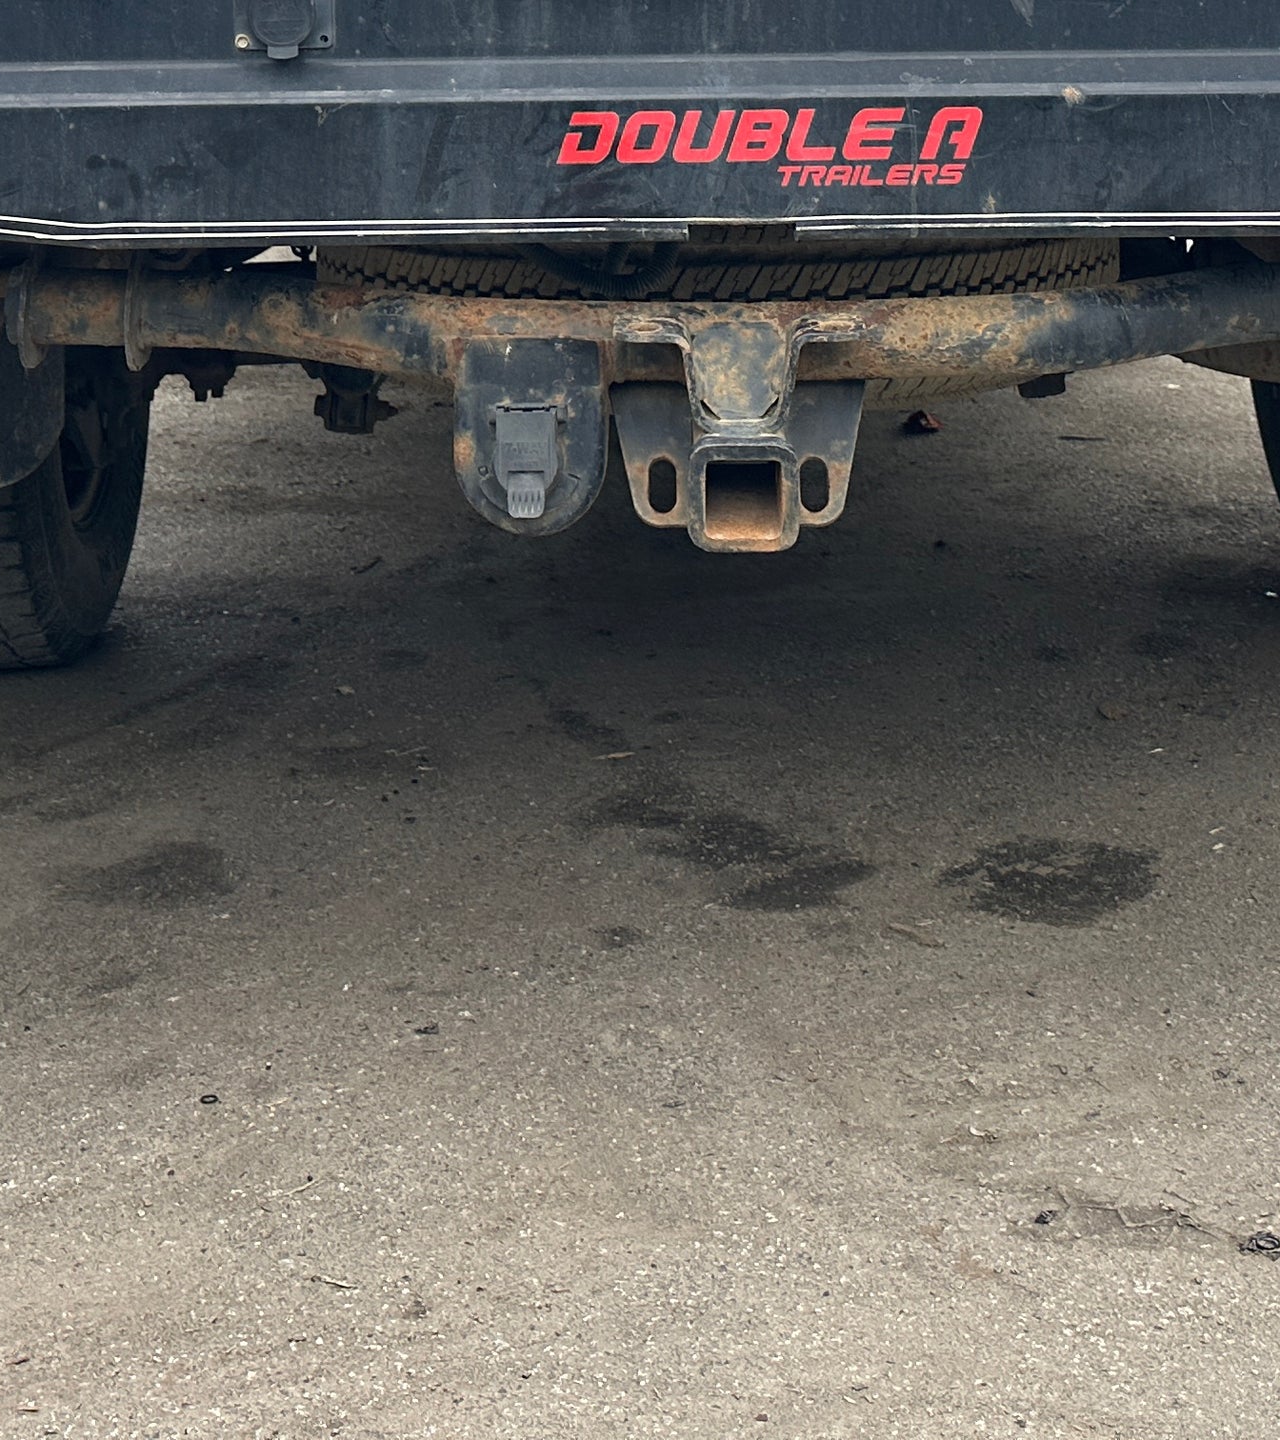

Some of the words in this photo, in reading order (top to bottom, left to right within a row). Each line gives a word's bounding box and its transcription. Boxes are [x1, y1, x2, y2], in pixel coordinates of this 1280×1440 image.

[556, 107, 906, 165] DOUBLE
[920, 106, 984, 160] A
[777, 163, 966, 187] TRAILERS
